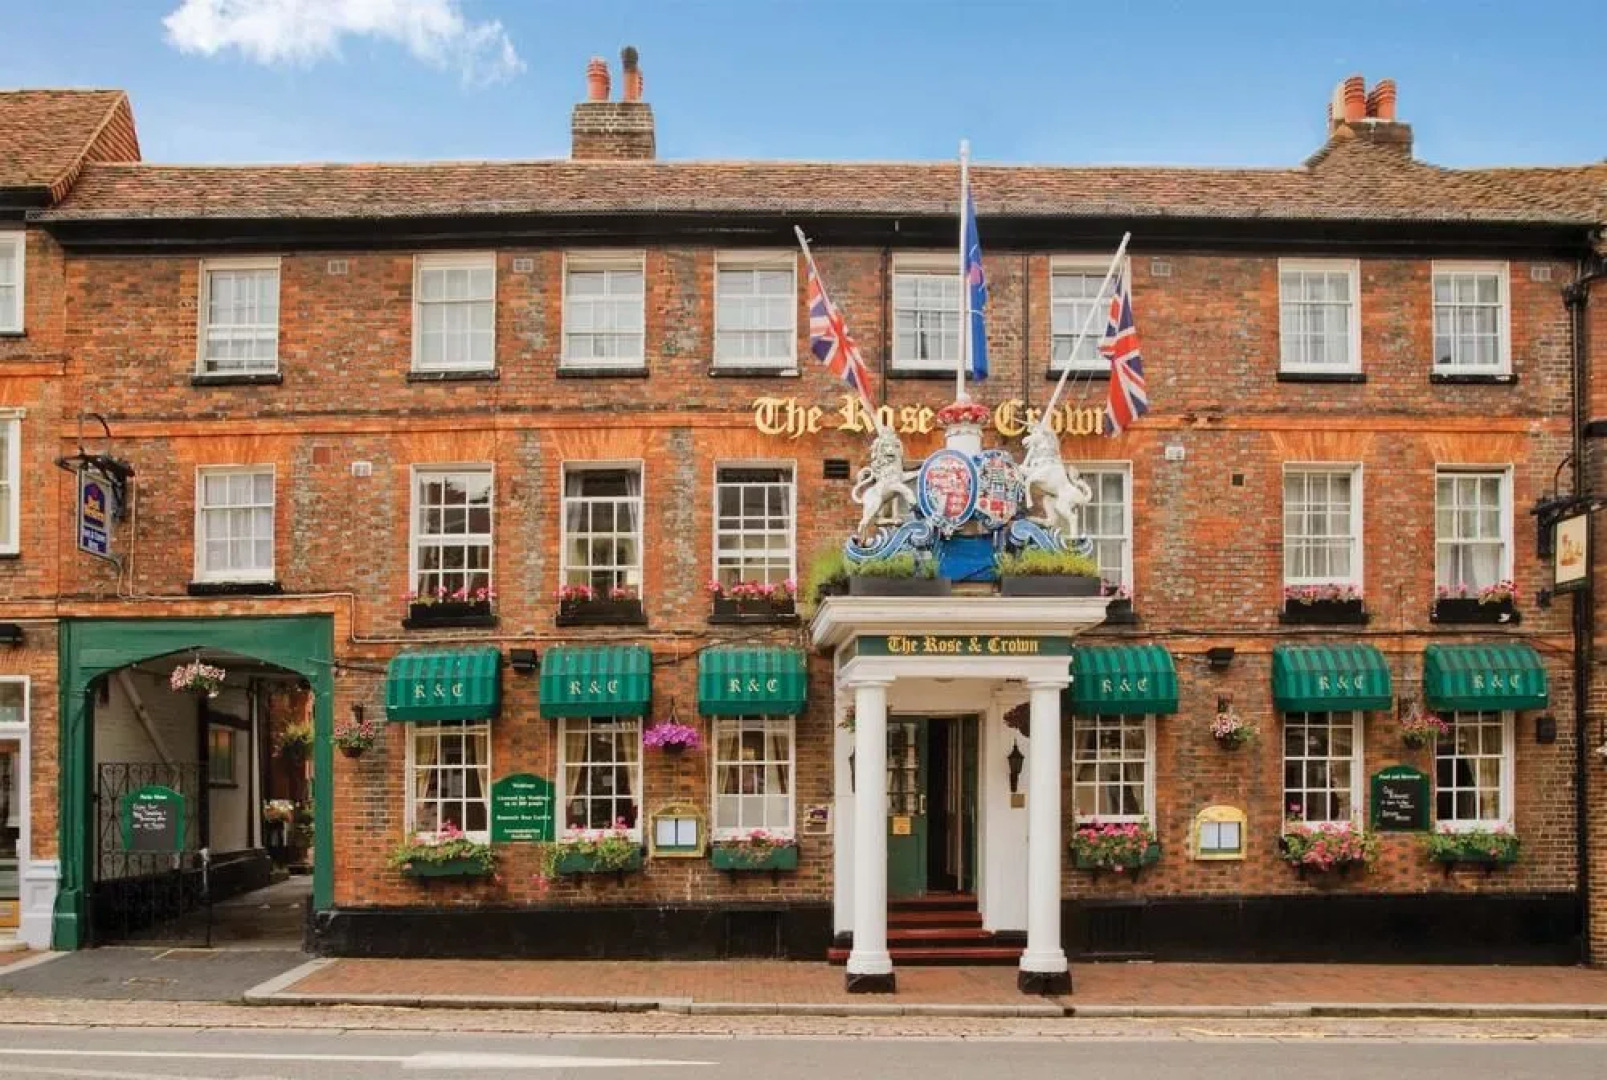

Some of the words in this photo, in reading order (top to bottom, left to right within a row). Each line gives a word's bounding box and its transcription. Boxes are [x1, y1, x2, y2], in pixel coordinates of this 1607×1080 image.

[752, 397, 823, 439] The
[837, 394, 934, 433] Rose
[887, 636, 918, 654] The
[923, 635, 962, 652] Rose
[968, 636, 982, 652] &
[988, 636, 1039, 653] Crown
[568, 681, 581, 695] R
[589, 681, 601, 694] &
[608, 680, 618, 694] C
[728, 679, 741, 693] R
[748, 678, 760, 692] &
[766, 678, 778, 693] C
[1102, 679, 1112, 693] R
[1119, 678, 1131, 692] &
[1137, 677, 1147, 692] C
[1319, 676, 1330, 690] R
[1337, 676, 1348, 689] &
[1354, 675, 1363, 689] C
[1473, 675, 1484, 689] R
[1491, 675, 1503, 688] &
[1510, 675, 1520, 689] C
[413, 684, 426, 698] R
[433, 683, 446, 697] &
[452, 683, 463, 697] C
